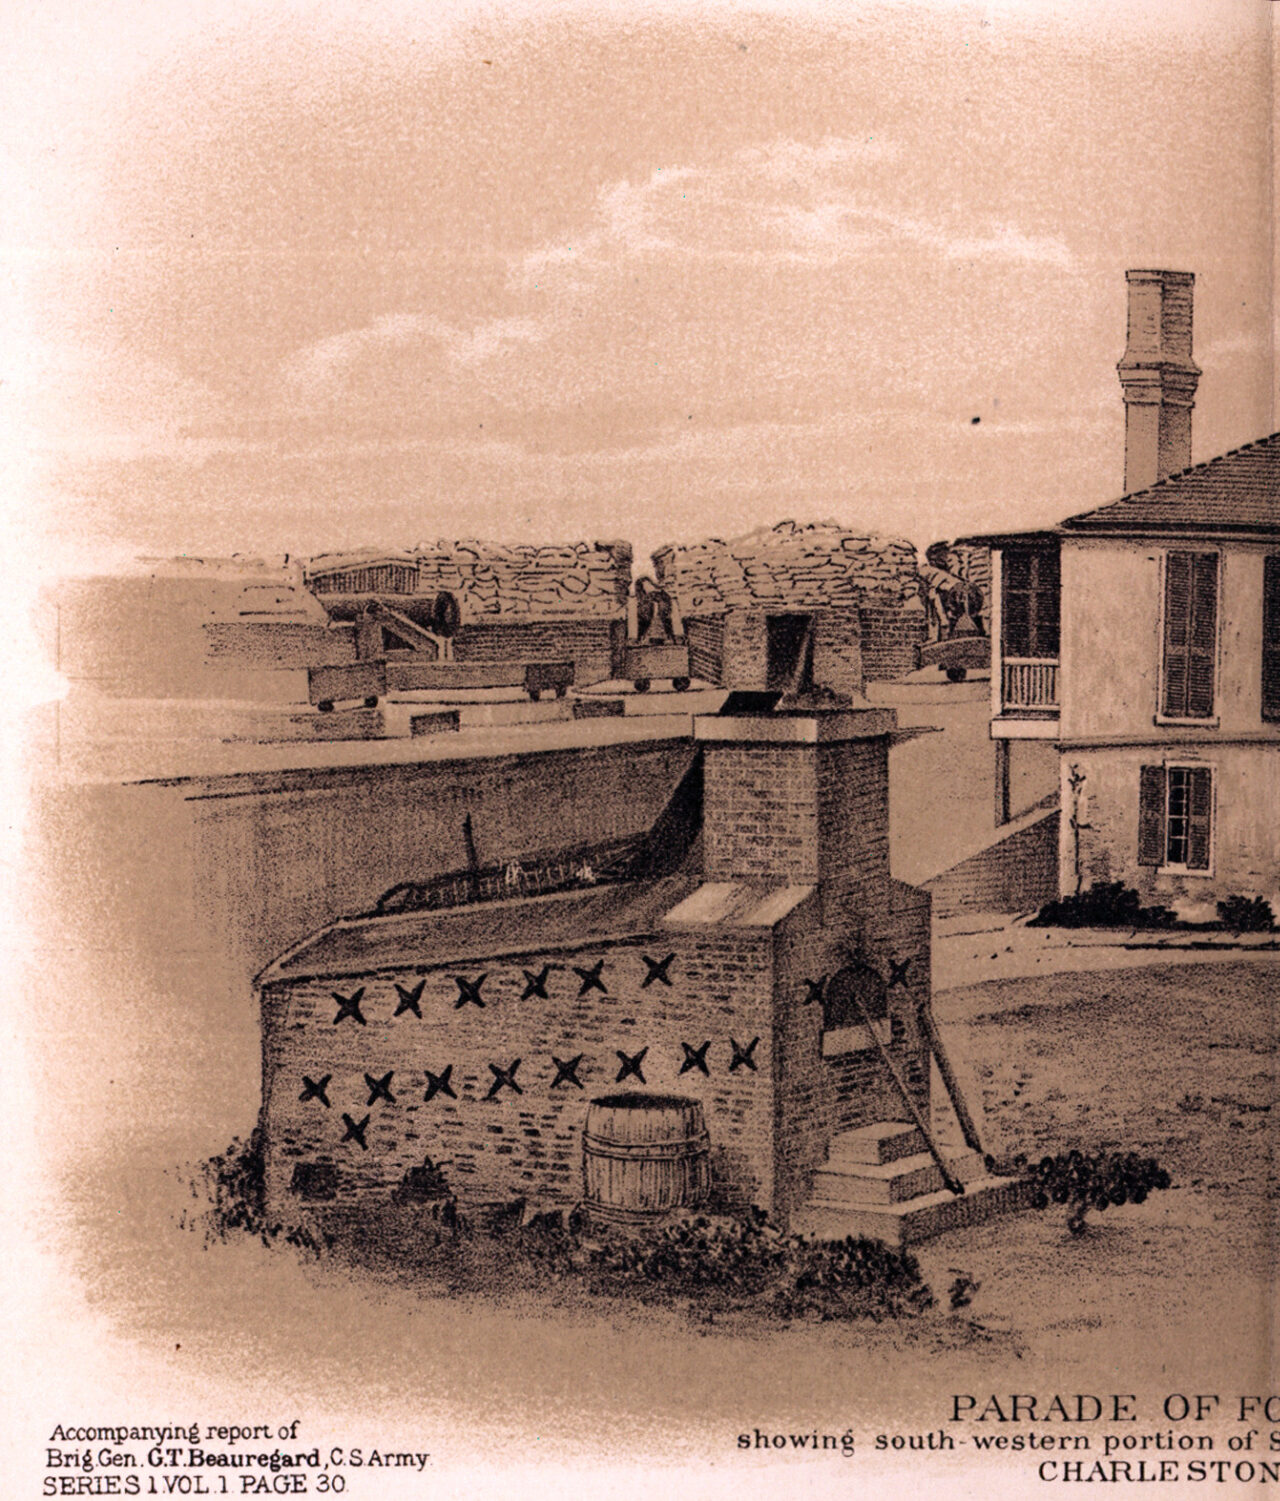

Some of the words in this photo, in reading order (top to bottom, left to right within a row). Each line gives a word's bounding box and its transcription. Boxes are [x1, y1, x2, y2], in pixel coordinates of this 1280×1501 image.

[948, 1393, 1137, 1422] PARADE
[1163, 1393, 1220, 1422] OF
[48, 1422, 201, 1446] Accompanying
[205, 1424, 273, 1446] report
[277, 1419, 301, 1440] of
[737, 1429, 855, 1458] showing
[1103, 1430, 1214, 1456] portion
[1227, 1429, 1259, 1451] of
[42, 1474, 141, 1497] SERIES
[239, 1473, 308, 1495] PAGE
